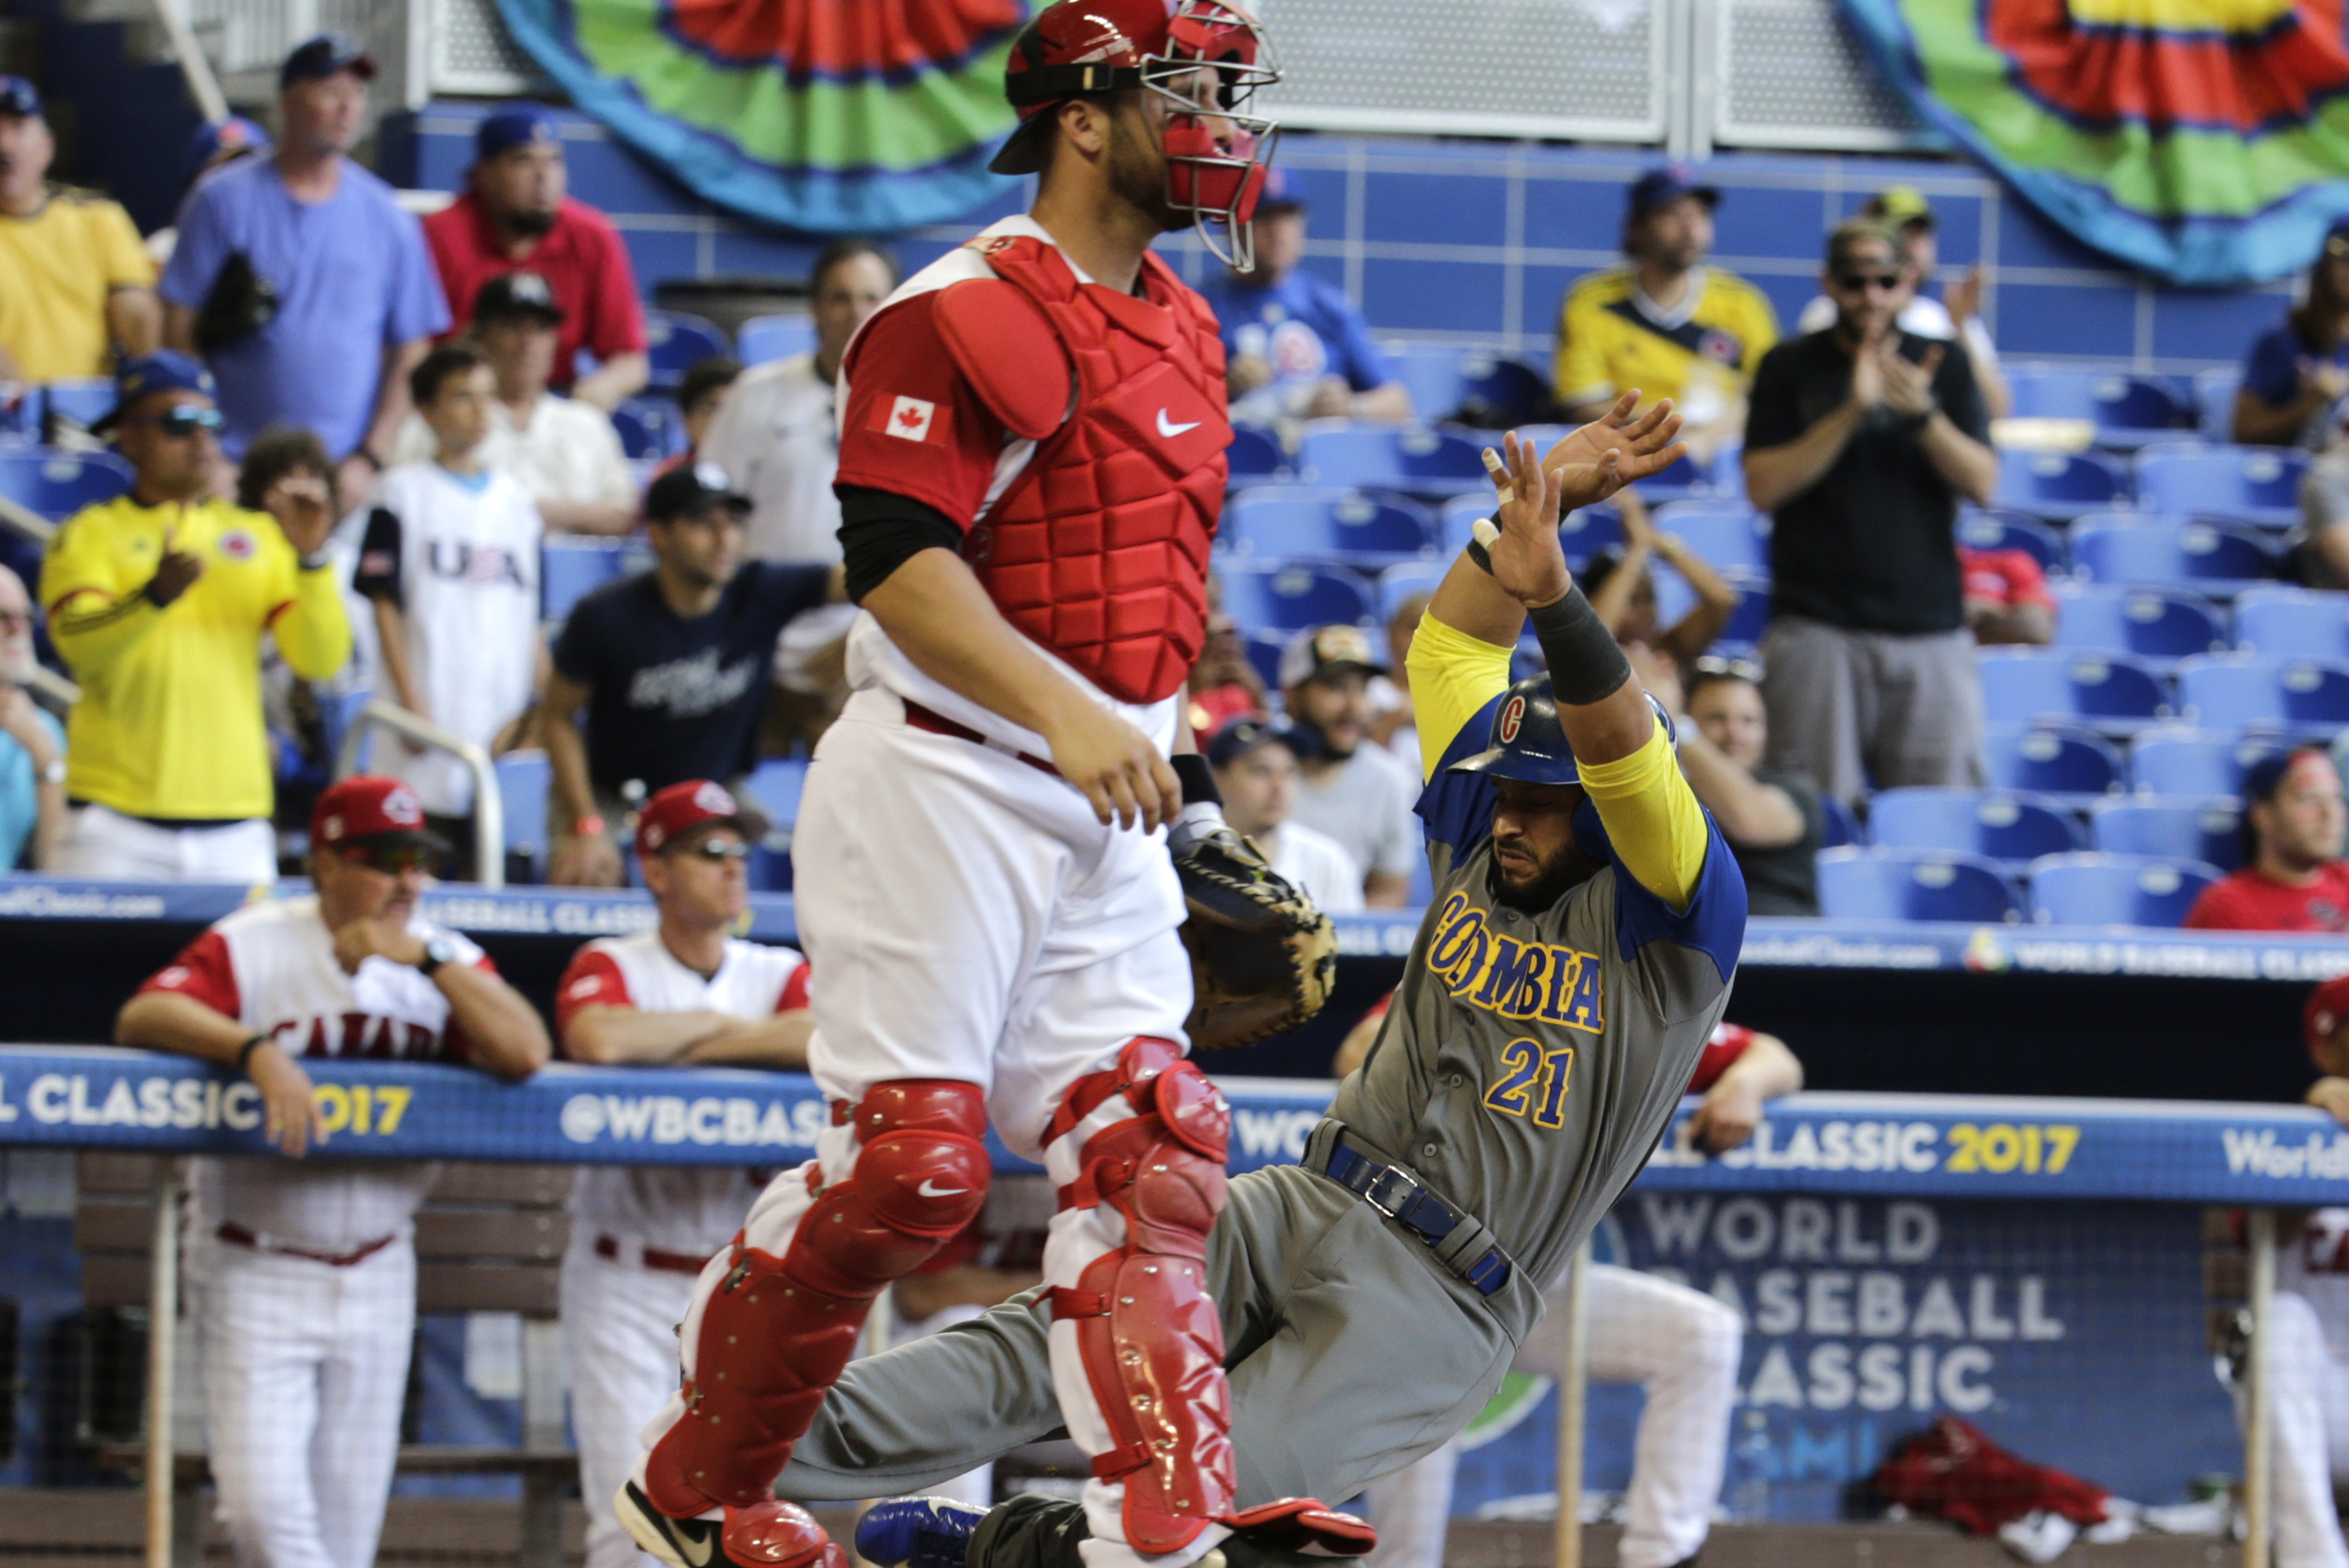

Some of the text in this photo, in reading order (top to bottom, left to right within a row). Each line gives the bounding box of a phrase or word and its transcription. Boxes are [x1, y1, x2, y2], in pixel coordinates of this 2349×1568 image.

[1501, 695, 1526, 744] C
[27, 1073, 261, 1130] CLASSIC
[1484, 1037, 1574, 1130] 21
[1946, 1123, 2081, 1174] 2017
[1643, 1194, 1940, 1262] WORLD
